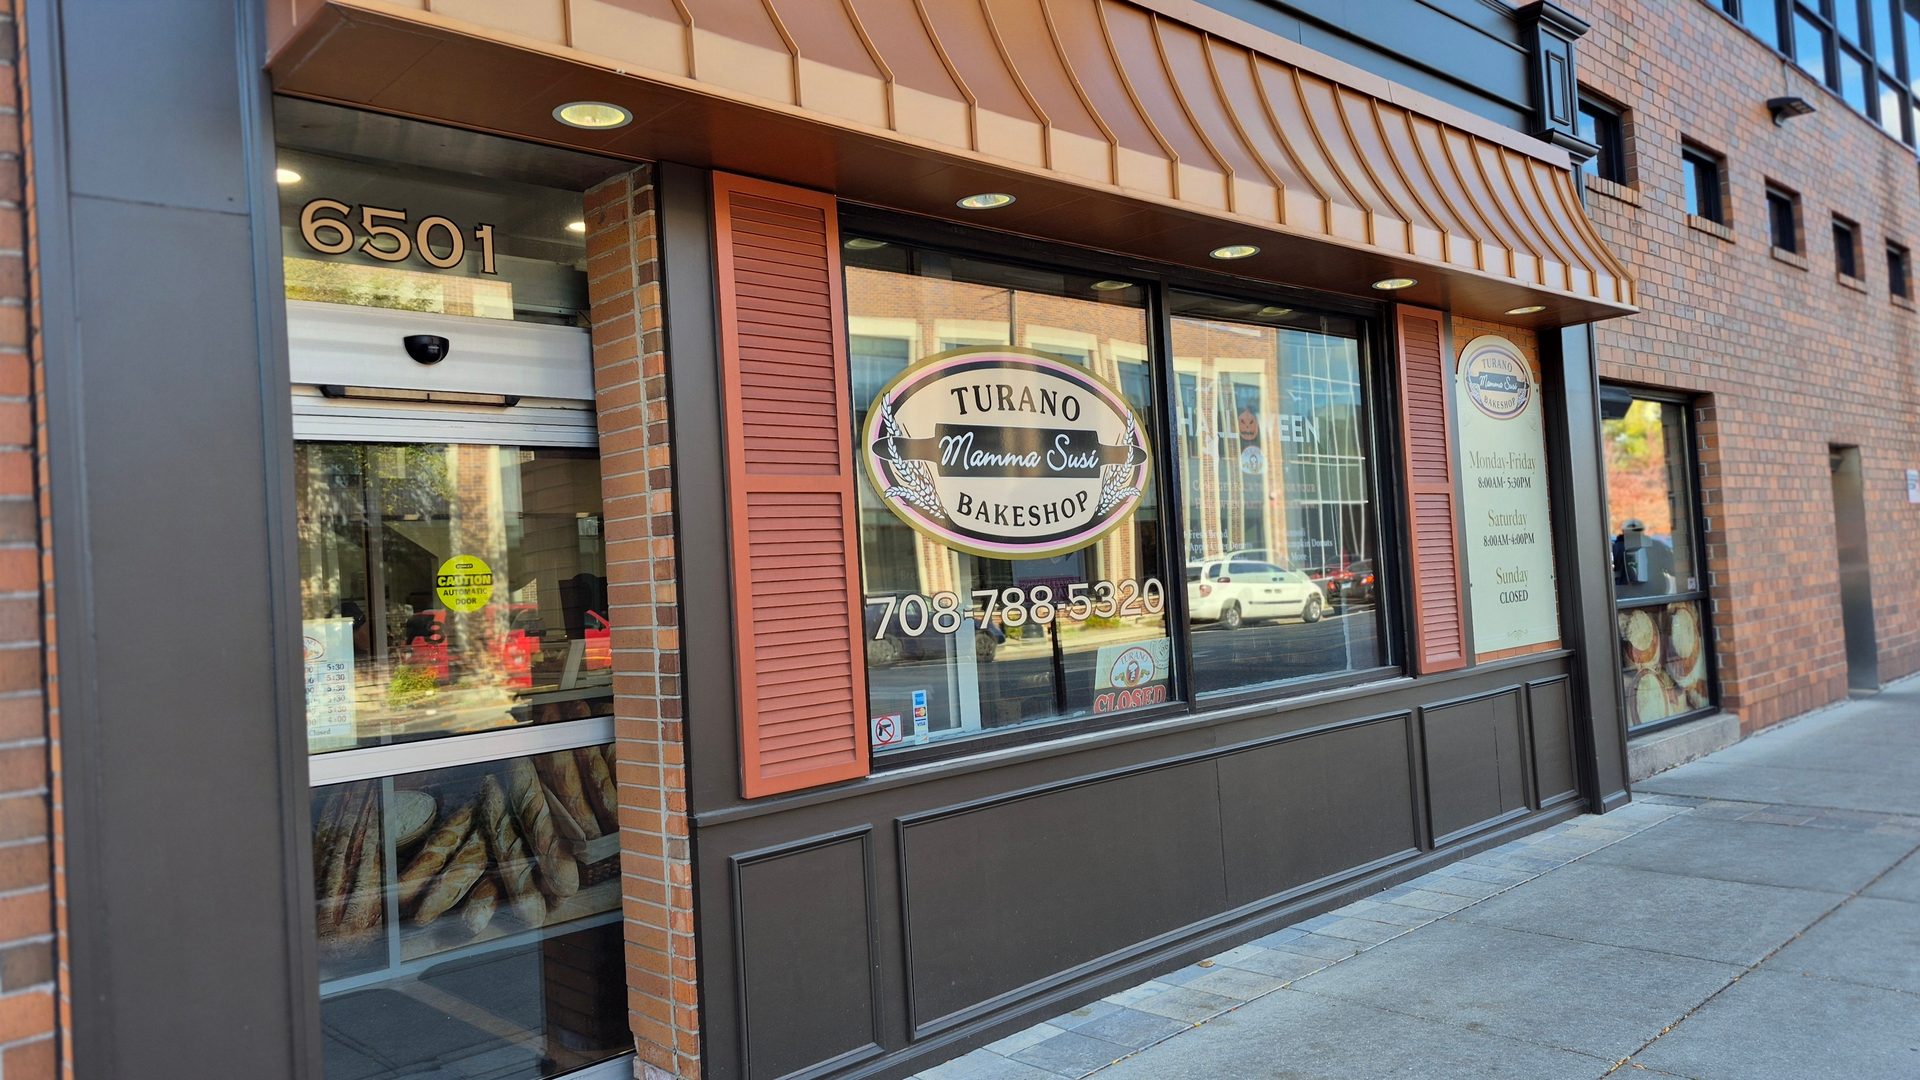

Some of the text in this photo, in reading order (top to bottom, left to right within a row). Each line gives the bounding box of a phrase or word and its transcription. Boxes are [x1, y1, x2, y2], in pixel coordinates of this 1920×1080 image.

[299, 197, 498, 275] 6501
[1482, 358, 1513, 372] TURANO
[950, 384, 1081, 422] TURANO
[1484, 394, 1516, 409] BAKESHOP
[938, 431, 1099, 472] Mamma Susi
[1469, 450, 1536, 475] Monday-Friday
[956, 490, 1088, 527] BAKESHOP
[1487, 508, 1527, 531] Saturday
[437, 574, 492, 587] CAUTION
[1495, 566, 1528, 587] Sunday
[443, 587, 488, 596] AUTOMATIC
[455, 597, 477, 605] DOOR
[1499, 589, 1529, 604] CLOSED
[865, 577, 1165, 641] 708-788-5320
[325, 663, 345, 671] 5:30
[325, 673, 345, 682] 5:30
[1093, 684, 1167, 714] CLOSED
